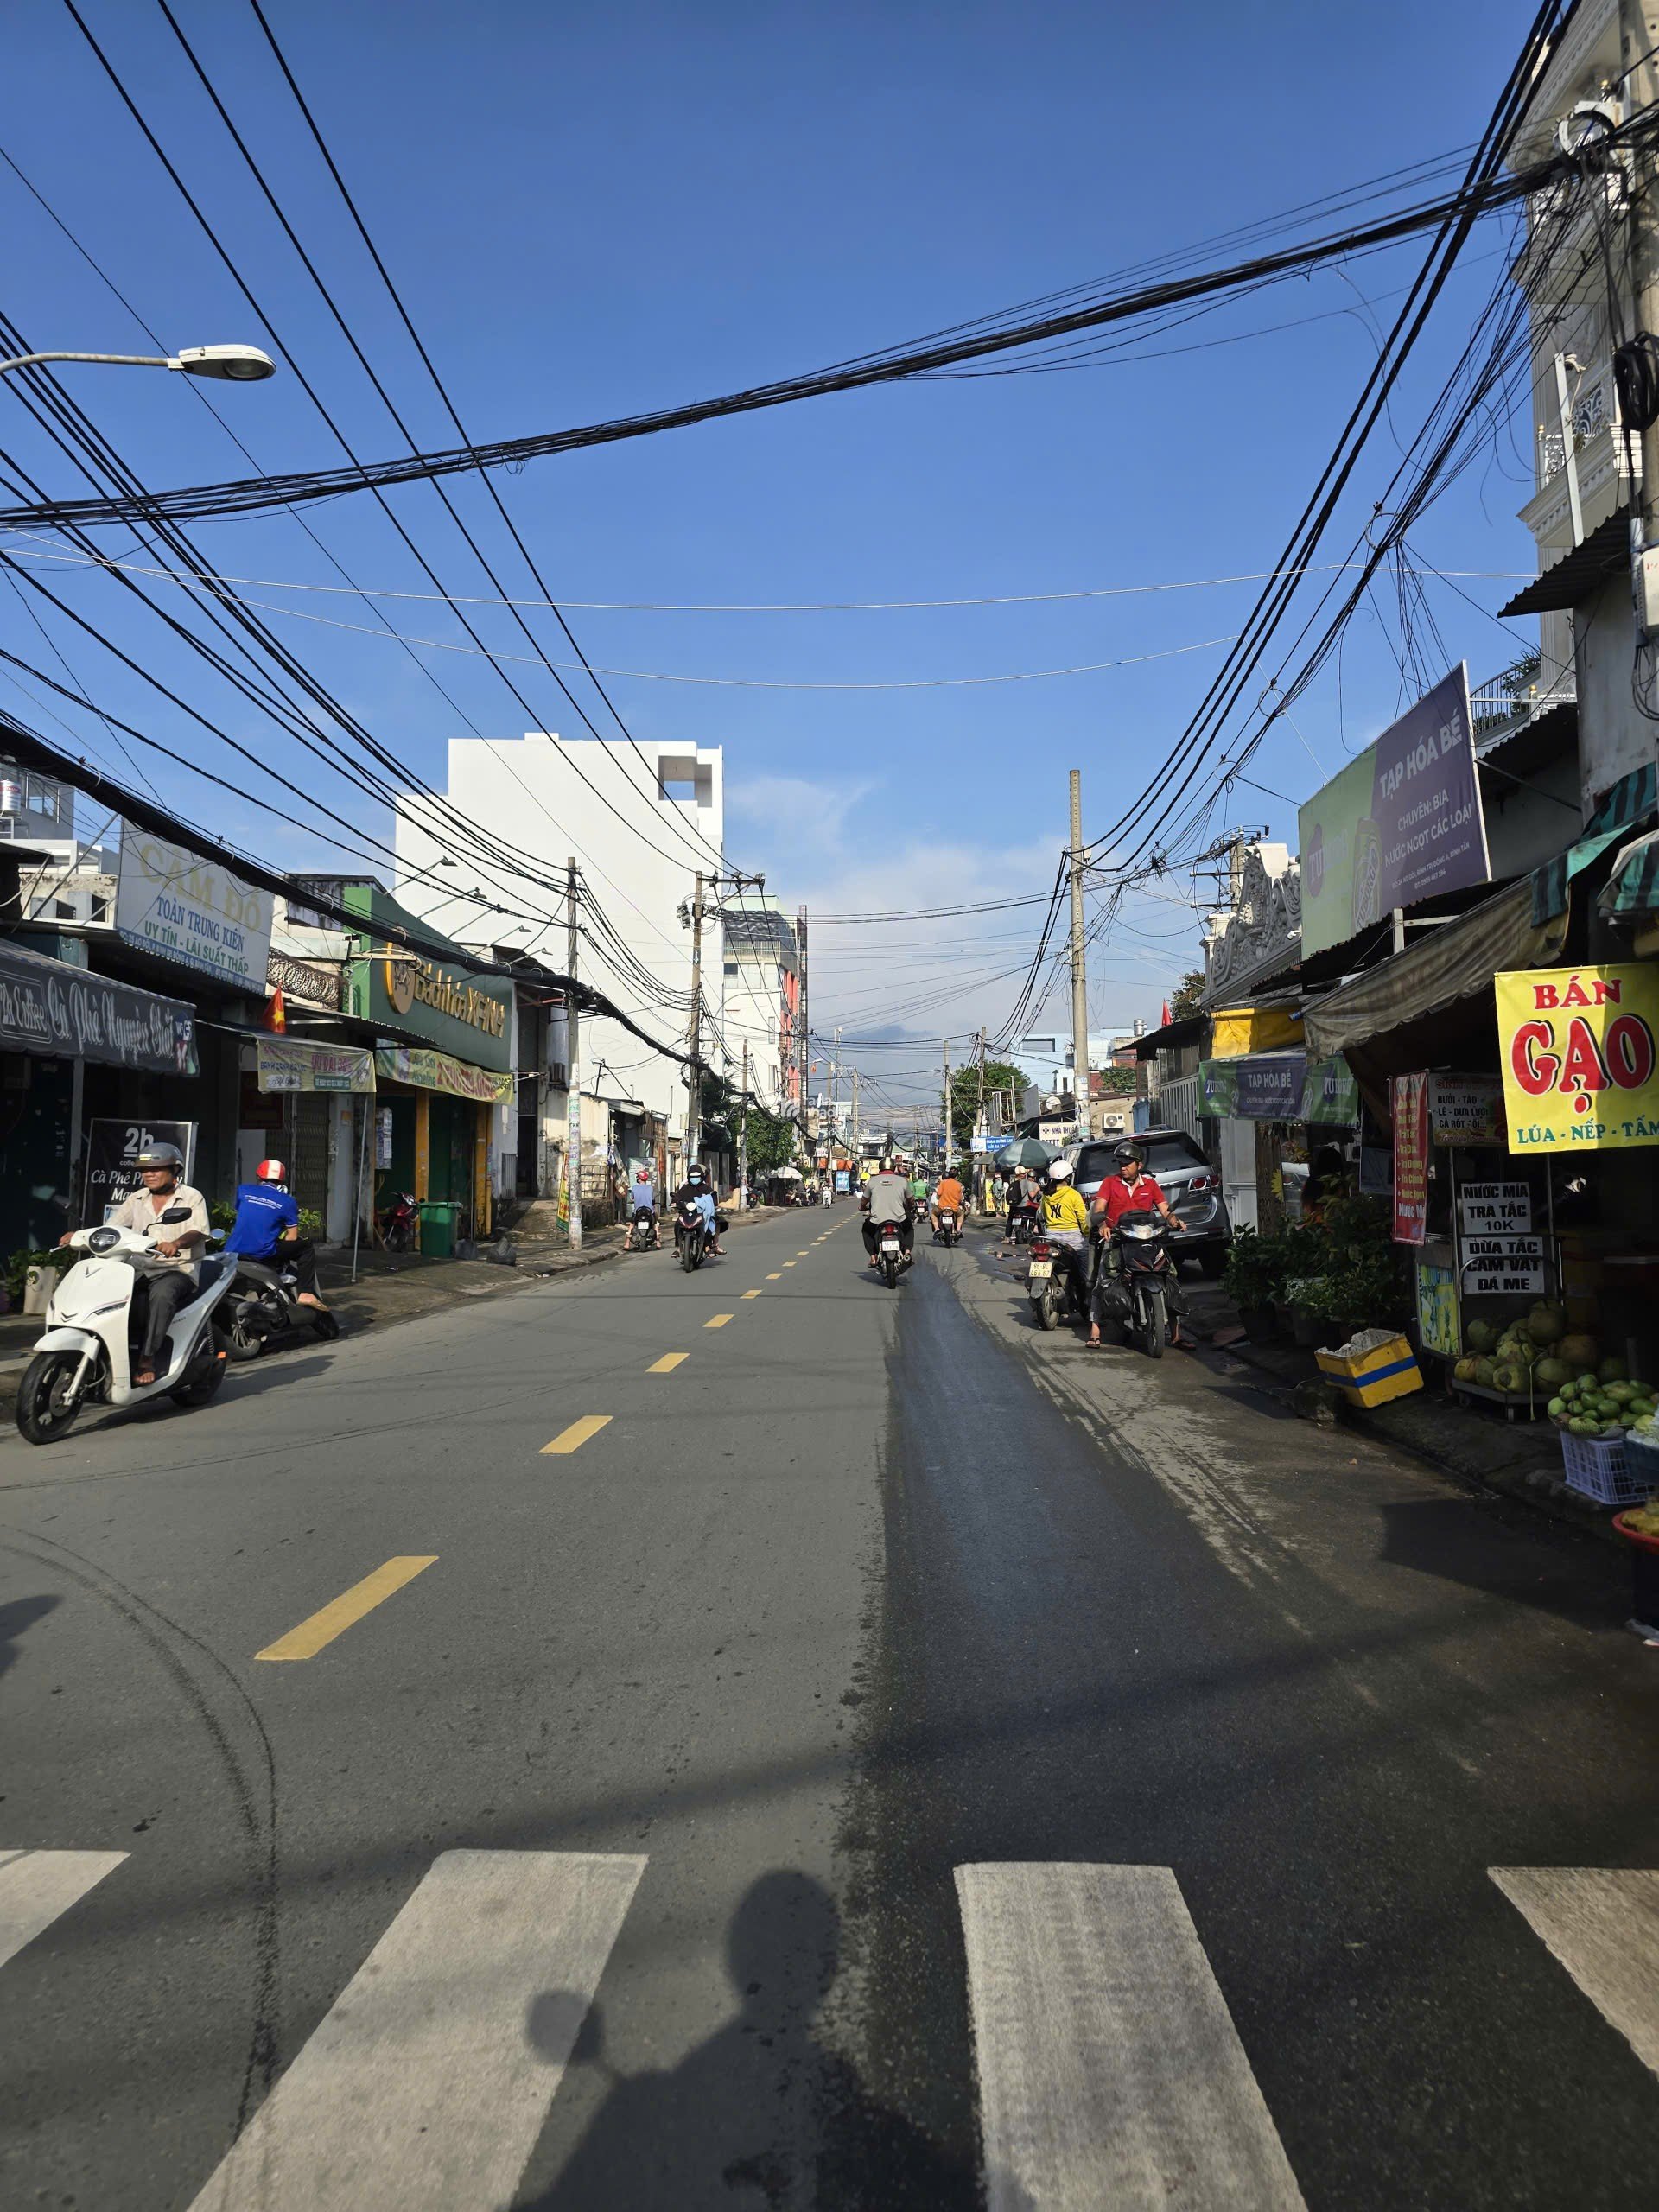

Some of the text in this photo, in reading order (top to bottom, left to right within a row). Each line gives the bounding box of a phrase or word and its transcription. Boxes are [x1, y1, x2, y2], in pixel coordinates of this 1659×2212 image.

[1380, 706, 1462, 801] TẠP HÓA BÉ
[1433, 788, 1449, 810] BIA
[1407, 829, 1429, 851] NGỌT
[1431, 817, 1449, 839] CÁC
[1450, 803, 1472, 829] LOẠI
[156, 895, 245, 953] TOÀN TRUNG KIÊN
[144, 920, 157, 937] UY
[162, 925, 177, 947] TÍN
[203, 944, 226, 967] SUẤT
[228, 954, 249, 976] THẤP
[1533, 975, 1622, 1010] BÁN
[69, 982, 104, 1054] Phê
[1511, 1013, 1656, 1114] GẠO
[1248, 1069, 1292, 1092] TẠP HÓA BÉ
[1437, 1092, 1455, 1104] BƯỞI
[1438, 1107, 1447, 1116] LÊ
[1453, 1107, 1469, 1116] DƯA
[1439, 1117, 1449, 1128] CÀ
[1516, 1123, 1556, 1144] LÚA
[1570, 1118, 1605, 1141] NẾP
[91, 1169, 106, 1184] Cà
[108, 1170, 131, 1185] Phê
[1463, 1183, 1529, 1199] NƯỚC MÍA
[1467, 1201, 1528, 1219] TRÀ TẮC
[1484, 1220, 1515, 1231] 10K
[1469, 1237, 1538, 1255] DỪA TẮC
[1478, 1276, 1530, 1291] ĐÁ ME
